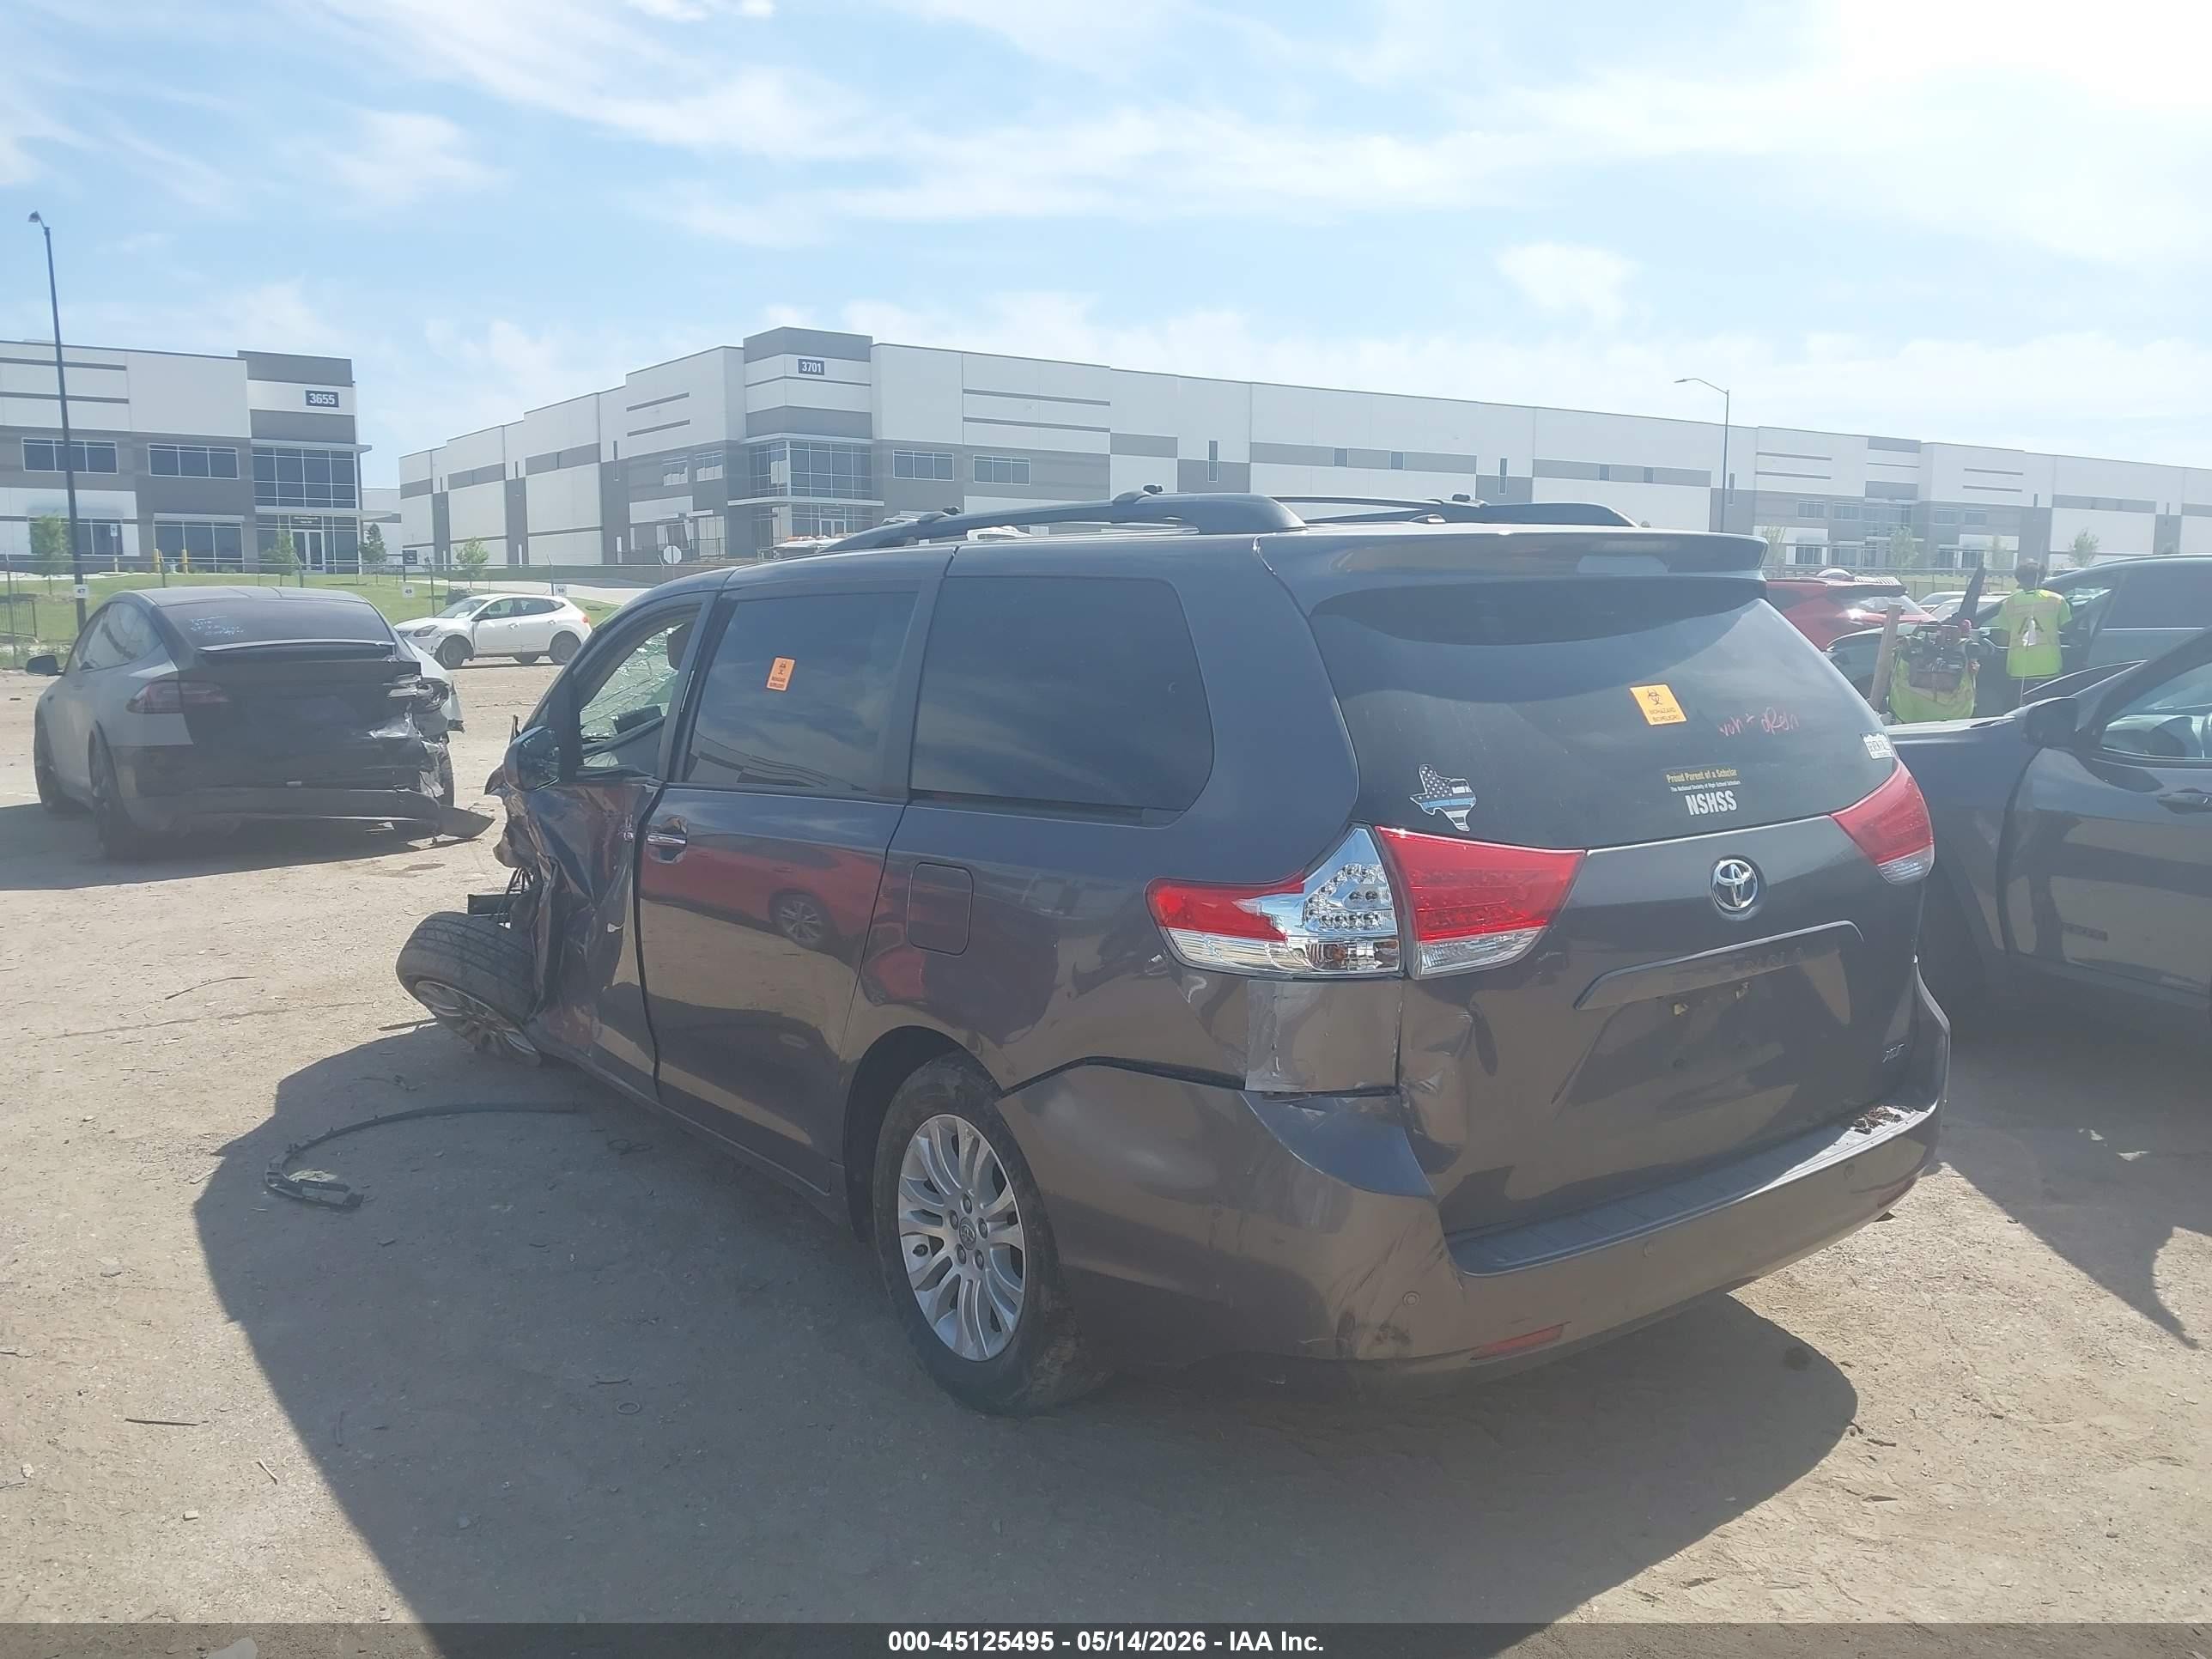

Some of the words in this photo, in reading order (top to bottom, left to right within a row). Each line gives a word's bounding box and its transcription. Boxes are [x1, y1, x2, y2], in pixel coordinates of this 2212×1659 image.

[802, 361, 821, 373] 3701
[308, 392, 336, 405] 3655
[1667, 774, 1685, 783] Proud
[1685, 772, 1705, 781] Parent
[1705, 769, 1711, 779] of
[1717, 769, 1737, 777] Scholar
[1685, 790, 1737, 815] NSHSS
